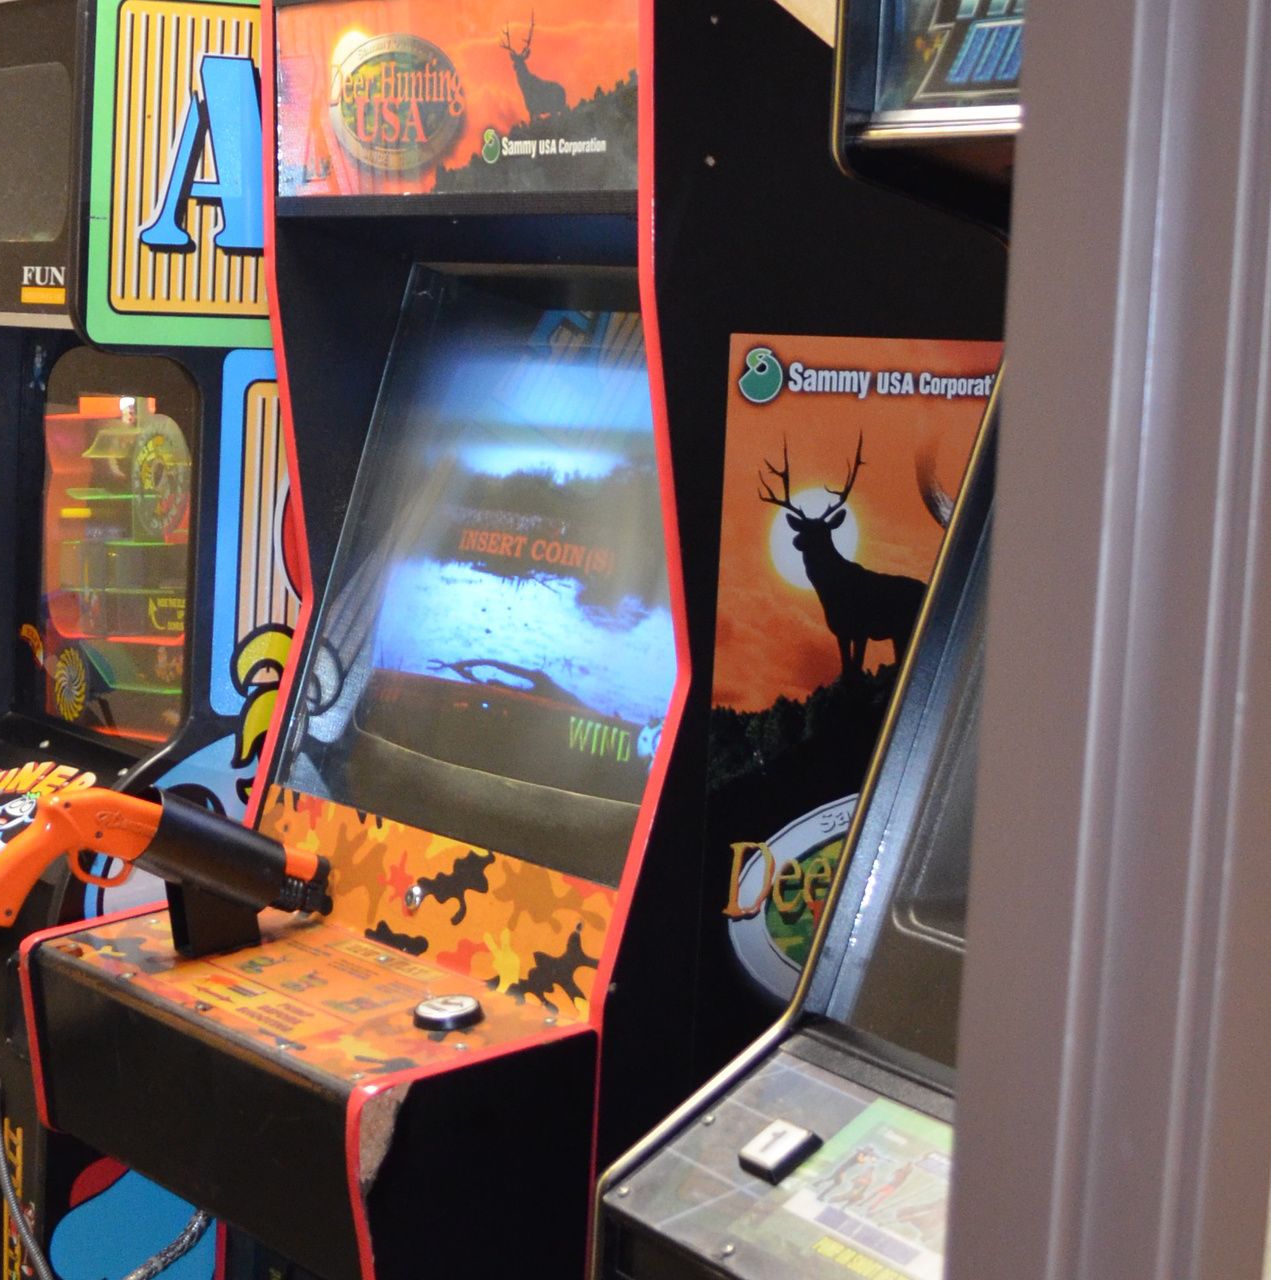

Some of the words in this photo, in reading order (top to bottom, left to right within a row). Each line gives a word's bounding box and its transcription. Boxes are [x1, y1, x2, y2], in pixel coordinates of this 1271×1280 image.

[329, 64, 373, 106] Deer
[380, 58, 465, 117] Hunting
[354, 96, 428, 144] USA
[501, 136, 538, 160] Sammy
[539, 140, 558, 155] USA
[558, 136, 607, 156] Corporation
[22, 266, 66, 286] FUN
[787, 362, 872, 400] Sammy
[876, 372, 914, 395] USA
[918, 371, 996, 400] Corporat
[460, 530, 528, 559] INSERT
[569, 715, 632, 763] WIND
[722, 841, 833, 918] Dee
